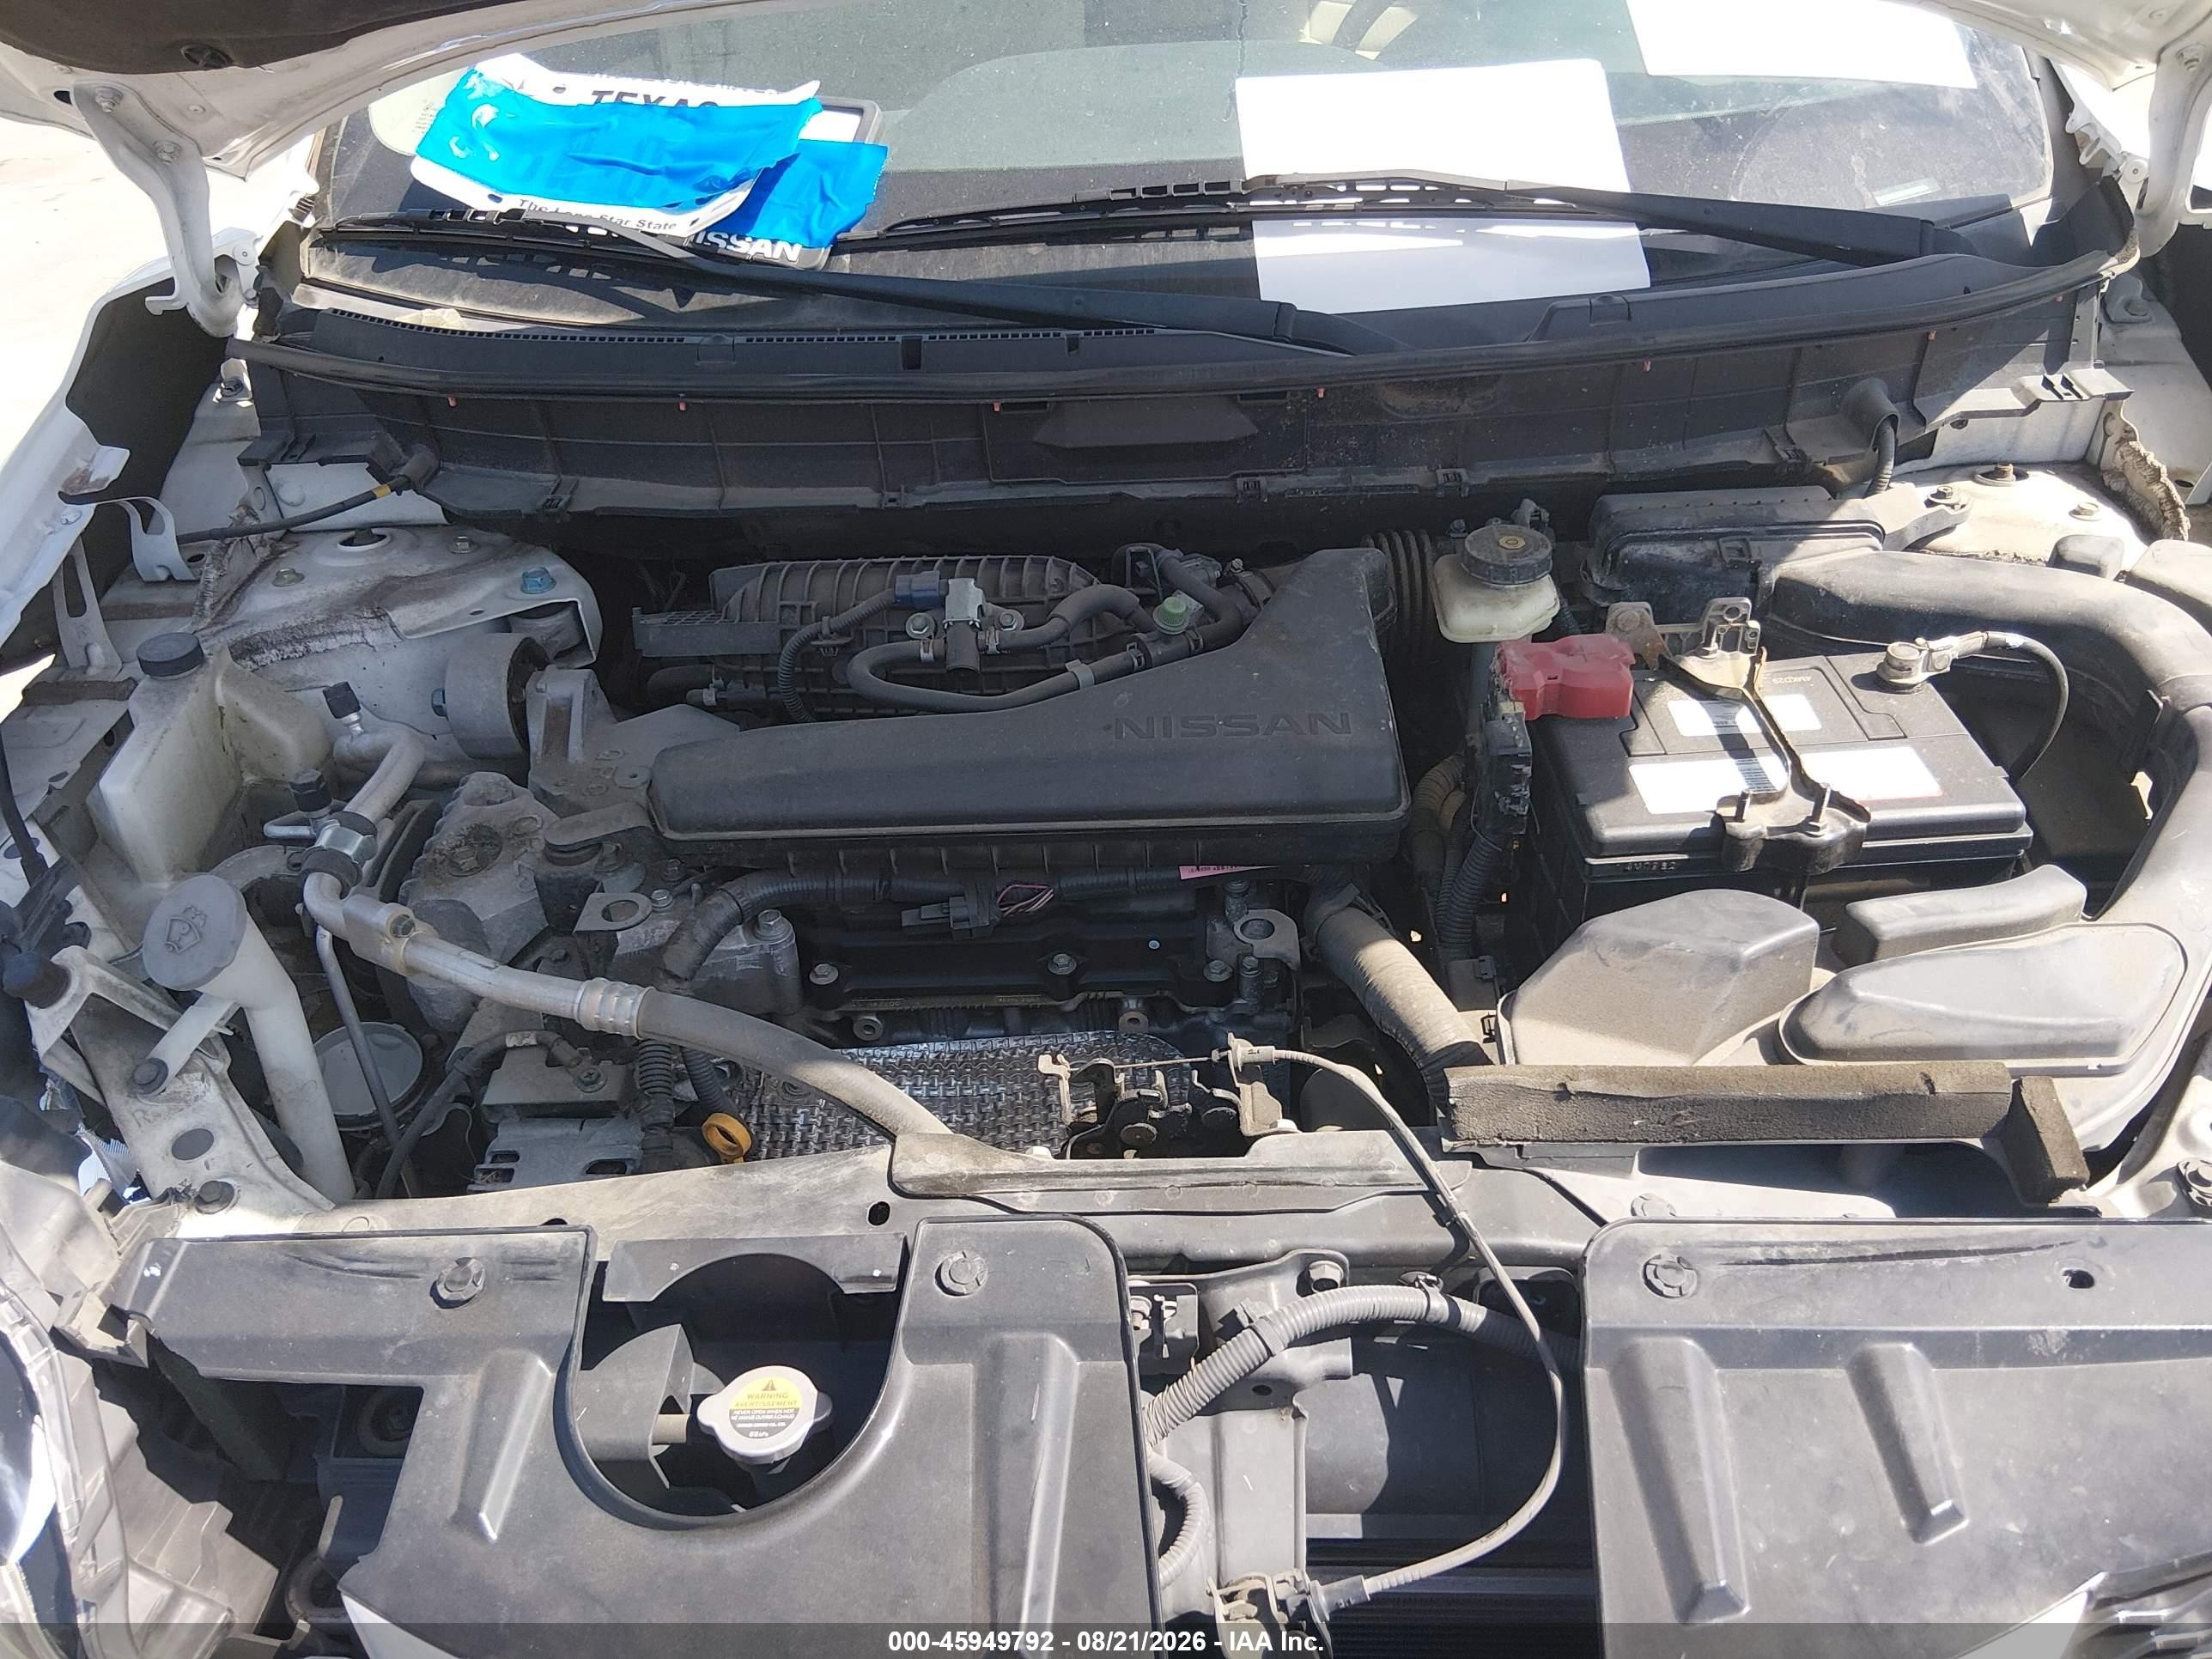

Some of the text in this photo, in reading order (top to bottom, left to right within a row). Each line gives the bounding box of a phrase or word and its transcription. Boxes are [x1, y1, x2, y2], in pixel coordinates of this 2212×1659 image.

[519, 198, 549, 212] The
[636, 219, 677, 230] State
[1114, 712, 1352, 740] NISSAN
